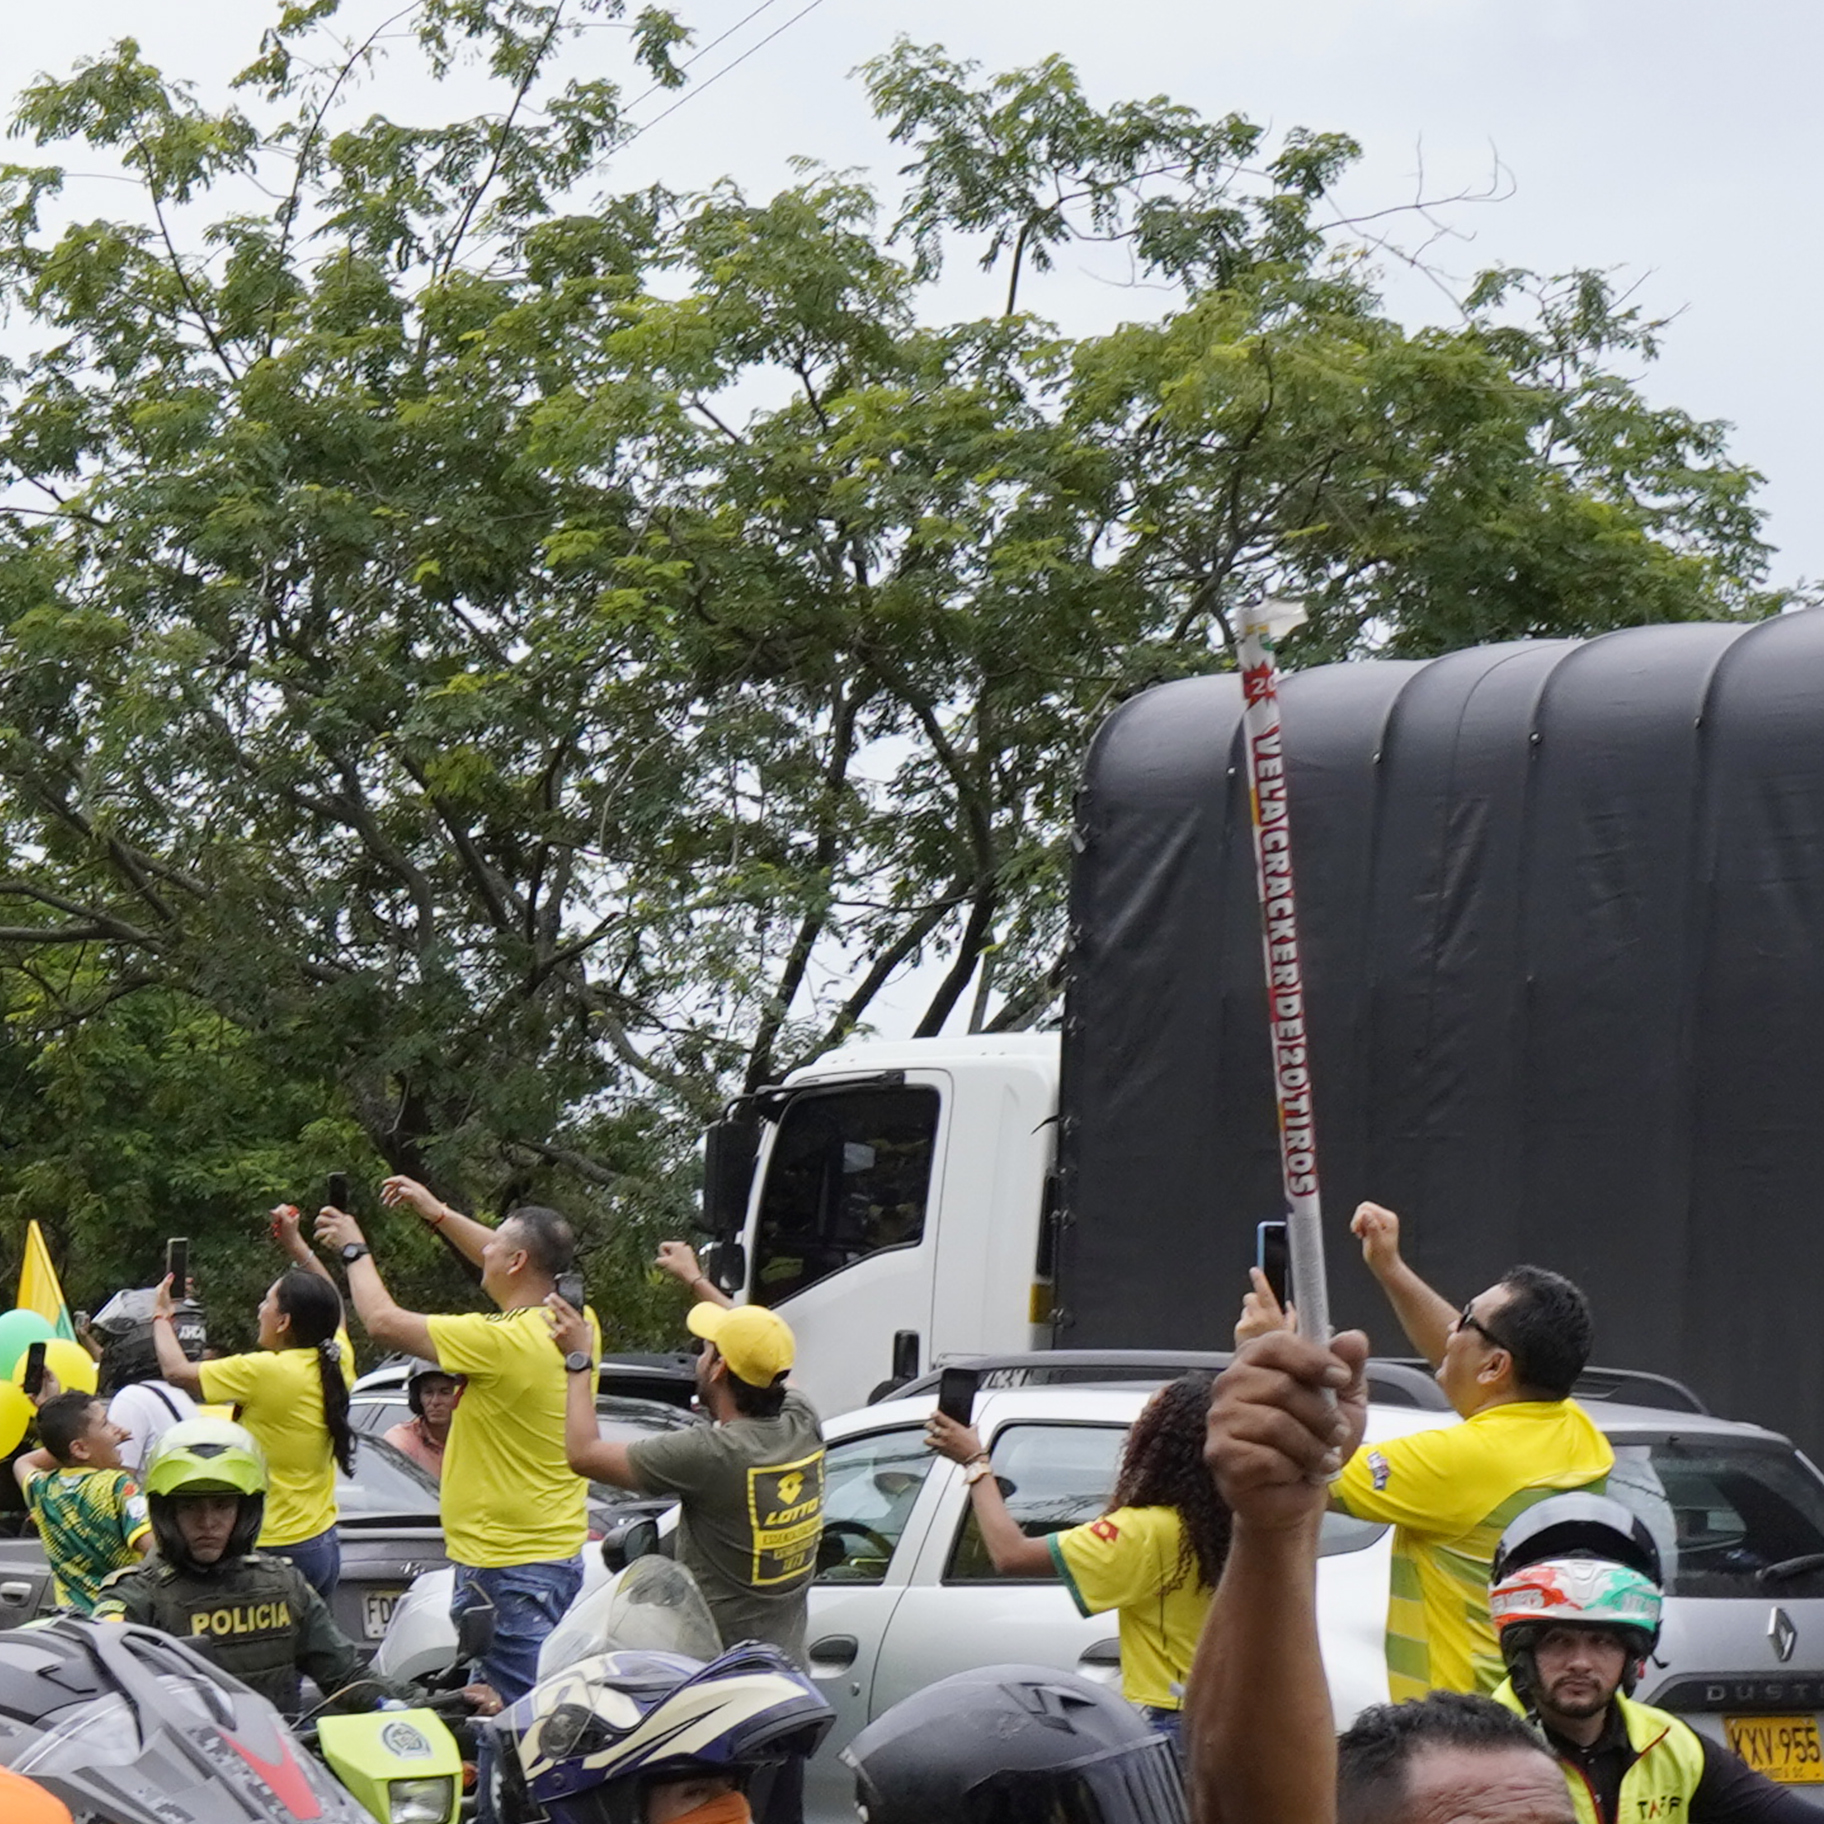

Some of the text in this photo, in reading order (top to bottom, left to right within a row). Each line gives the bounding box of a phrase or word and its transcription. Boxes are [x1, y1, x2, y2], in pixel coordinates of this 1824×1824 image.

[1252, 732, 1290, 827] VELA
[1260, 826, 1298, 996] CRACKER
[1281, 1099, 1316, 1199] TIROS
[763, 1496, 818, 1526] LOTTO
[190, 1601, 292, 1636] POLICIA
[1706, 1684, 1824, 1702] DUST
[1778, 1725, 1822, 1765] 955
